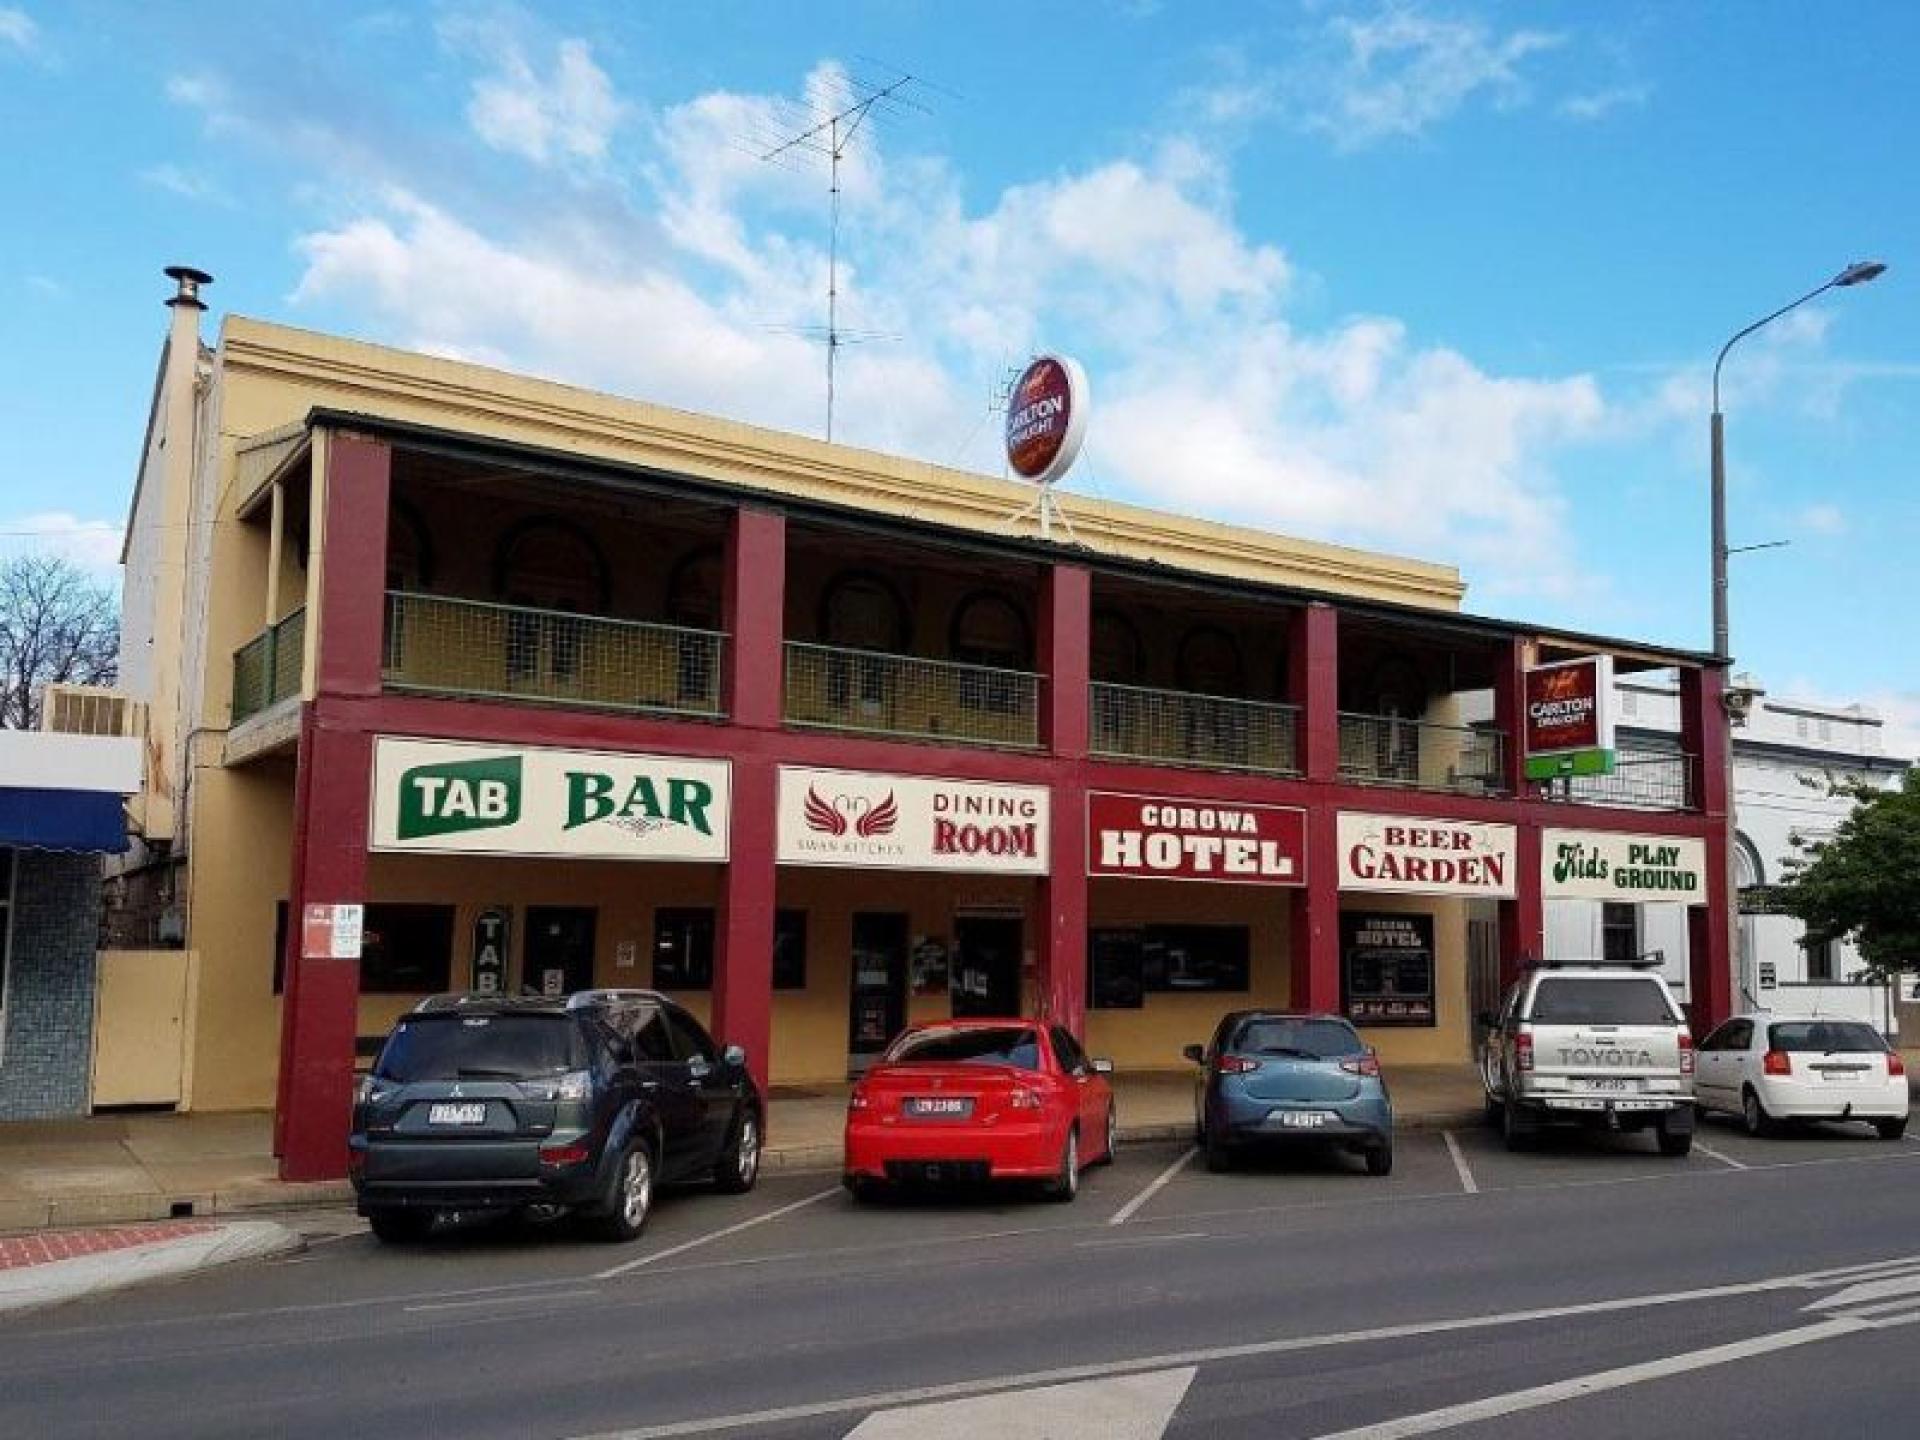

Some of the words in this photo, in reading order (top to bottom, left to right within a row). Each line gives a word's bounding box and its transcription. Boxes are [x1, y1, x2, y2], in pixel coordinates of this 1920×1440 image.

[1530, 696, 1593, 719] CARLTON
[413, 777, 508, 819] TAB
[562, 772, 714, 835] BAR
[933, 793, 1036, 818] DINING
[1141, 804, 1258, 834] COROWA
[933, 817, 1038, 858] ROOM
[1100, 830, 1294, 876] HOTEL
[1384, 826, 1473, 851] BEER
[1349, 844, 1506, 887] GARDEN
[1552, 842, 1609, 884] Kids
[1628, 844, 1681, 867] PLAY
[1614, 868, 1696, 892] GROUND
[478, 917, 500, 993] TAB
[1558, 1048, 1653, 1067] TOYOTA
